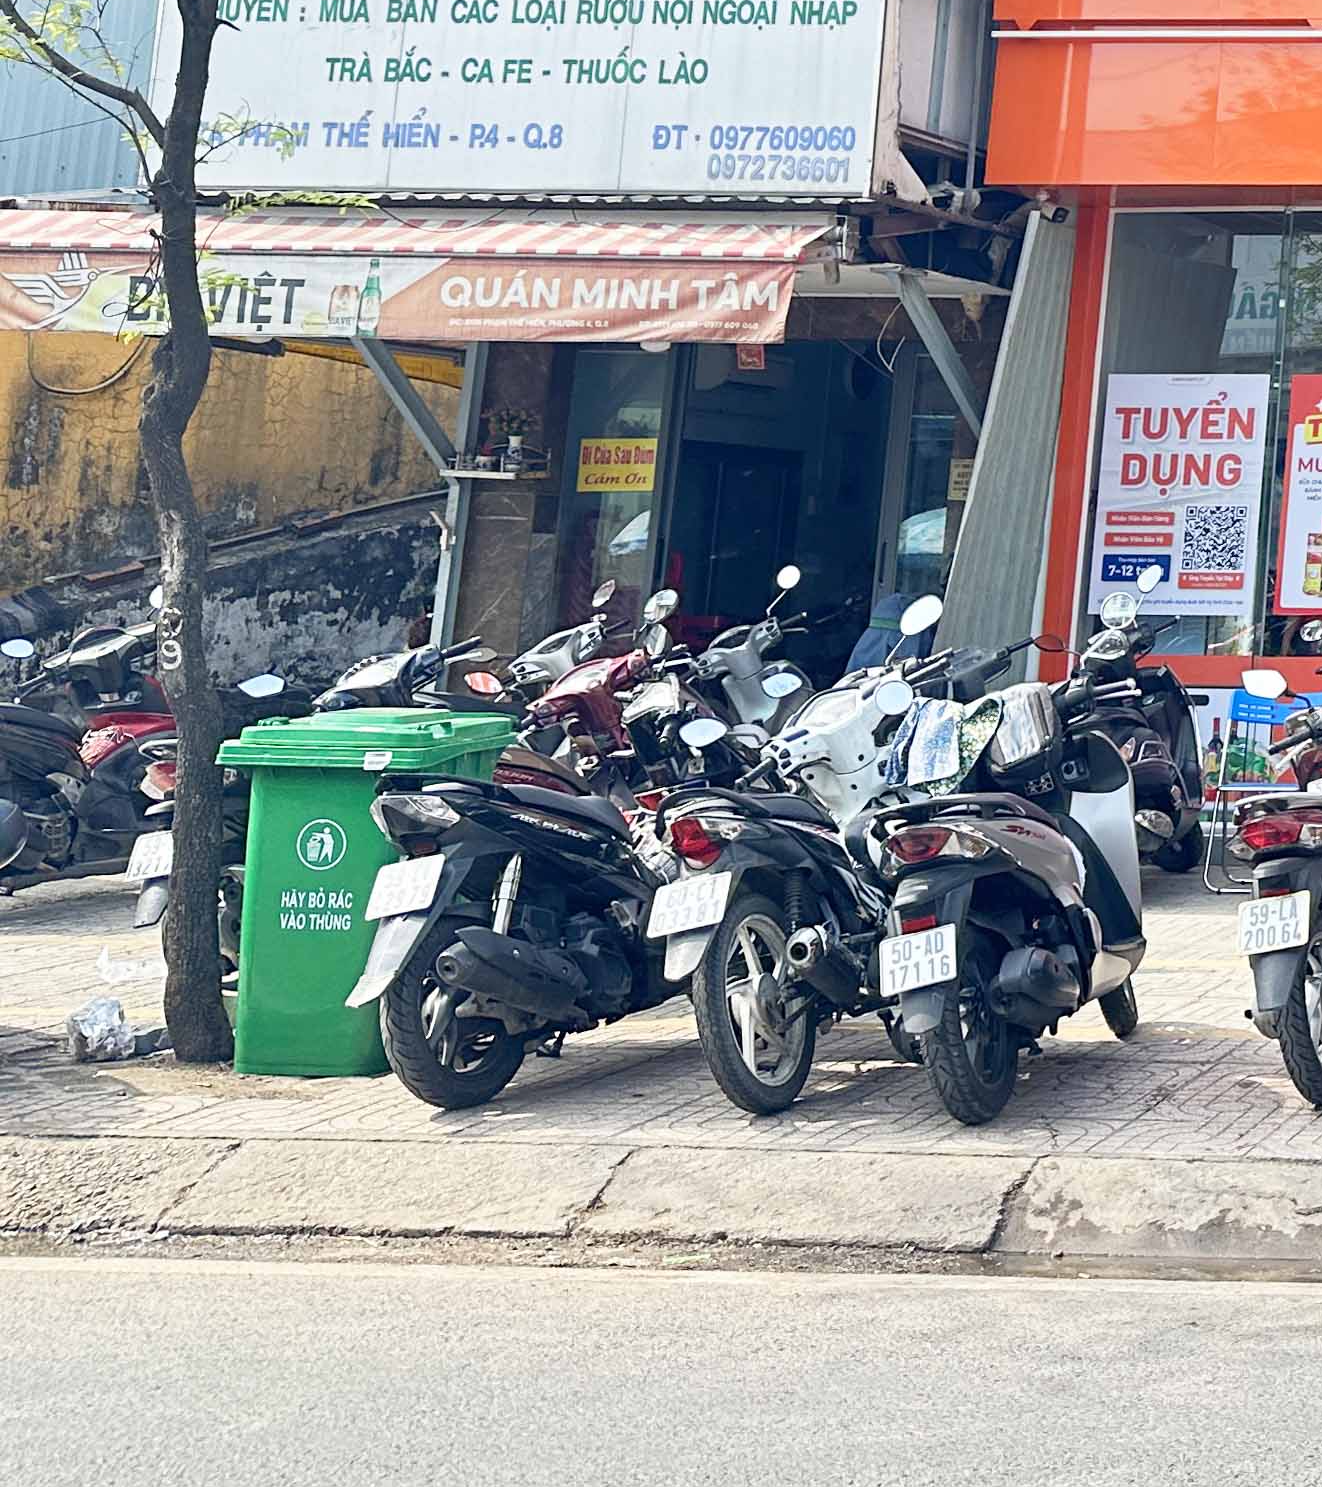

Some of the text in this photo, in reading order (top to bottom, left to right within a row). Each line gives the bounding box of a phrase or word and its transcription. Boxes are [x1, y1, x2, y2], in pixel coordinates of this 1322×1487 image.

[702, 0, 777, 31] NGOẠI
[326, 46, 709, 85] TRÀ BẮC CA FE THUỐC LÀO
[323, 110, 371, 148] THẾ
[382, 107, 440, 148] HIỂN
[523, 123, 563, 149] Q.8
[709, 126, 856, 151] 0977609060
[706, 153, 850, 184] 0972736601
[210, 270, 306, 332] VIỆT
[440, 270, 779, 312] QUÁN MINH TÂM
[1115, 391, 1256, 441] TUYỂN
[1120, 453, 1243, 497] DỤNG
[1108, 565, 1134, 577] 7-12
[281, 887, 353, 909] HÃY BỎ RÁC
[1249, 899, 1298, 928] 59-LA
[279, 912, 351, 930] VÀO THÙNG
[892, 931, 945, 965] 50-AD
